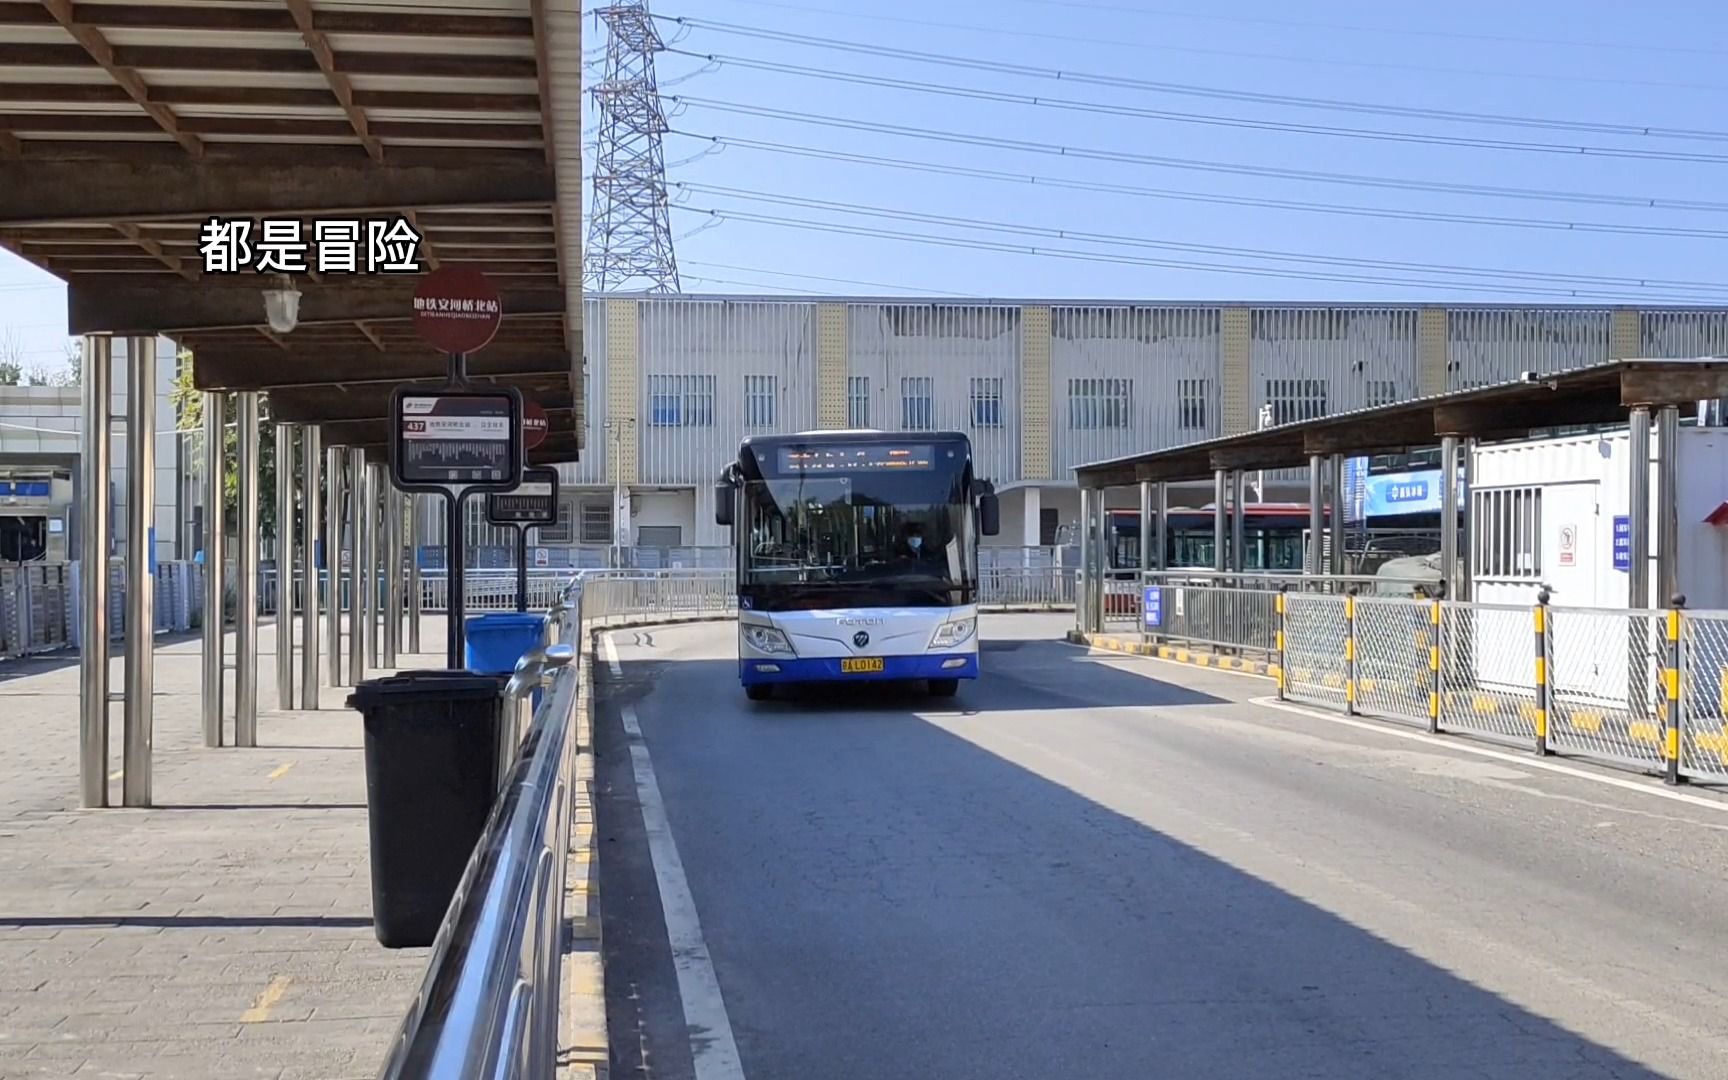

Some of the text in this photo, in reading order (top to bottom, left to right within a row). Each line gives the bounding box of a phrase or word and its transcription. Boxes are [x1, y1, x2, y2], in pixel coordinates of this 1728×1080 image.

[413, 297, 498, 313] 地铁安河桥北站
[407, 422, 425, 431] 437
